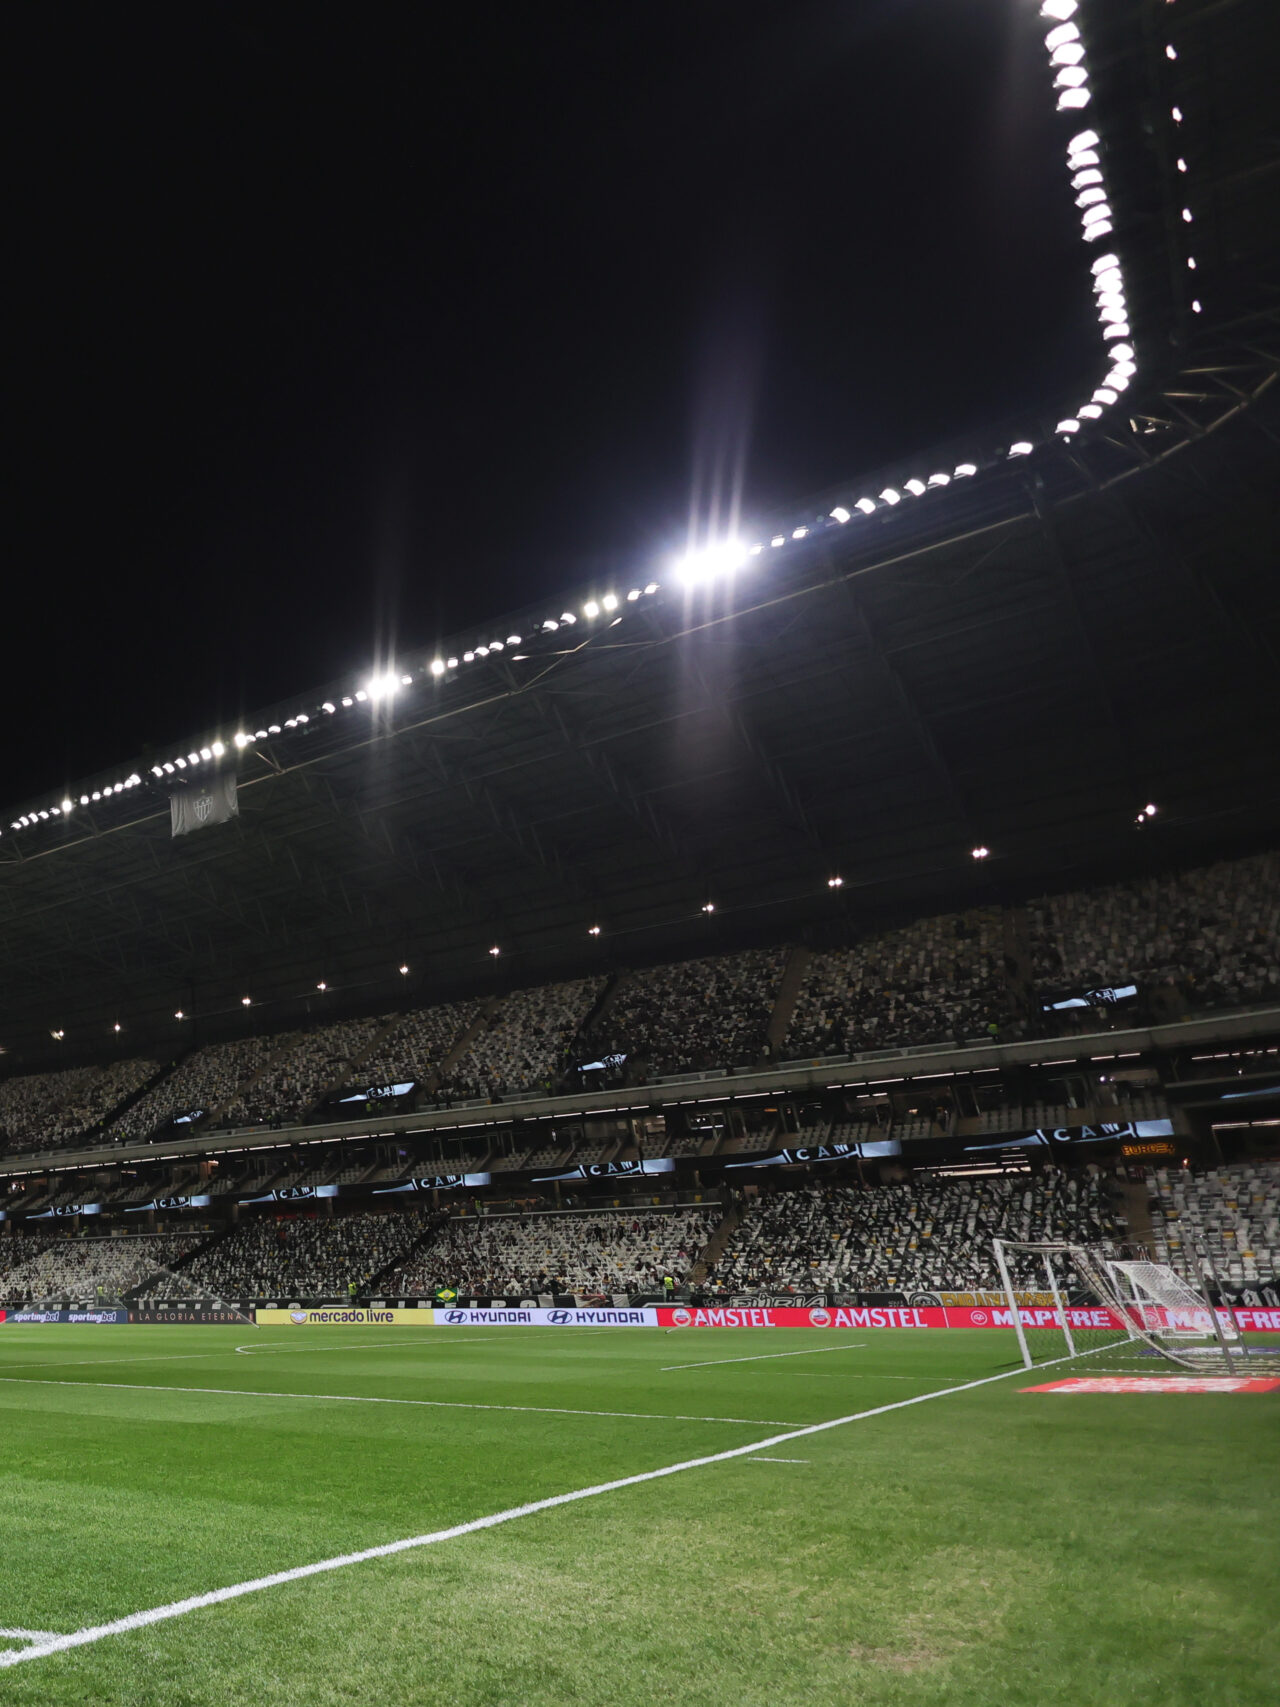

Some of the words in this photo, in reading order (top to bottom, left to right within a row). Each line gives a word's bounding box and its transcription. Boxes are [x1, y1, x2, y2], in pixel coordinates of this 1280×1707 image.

[14, 1311, 59, 1323] sportingbet
[68, 1311, 117, 1323] sportingbet
[138, 1313, 151, 1321] LA
[158, 1313, 195, 1321] GLORIA
[201, 1312, 242, 1321] ETERNA
[309, 1310, 365, 1323] mercado
[366, 1309, 394, 1323] livre
[470, 1311, 531, 1323] HYUNDAI
[576, 1312, 645, 1324] HYUNDAI
[694, 1308, 776, 1327] AMSTEL
[835, 1308, 929, 1328] AMSTEL
[993, 1310, 1111, 1327] MAPFRE
